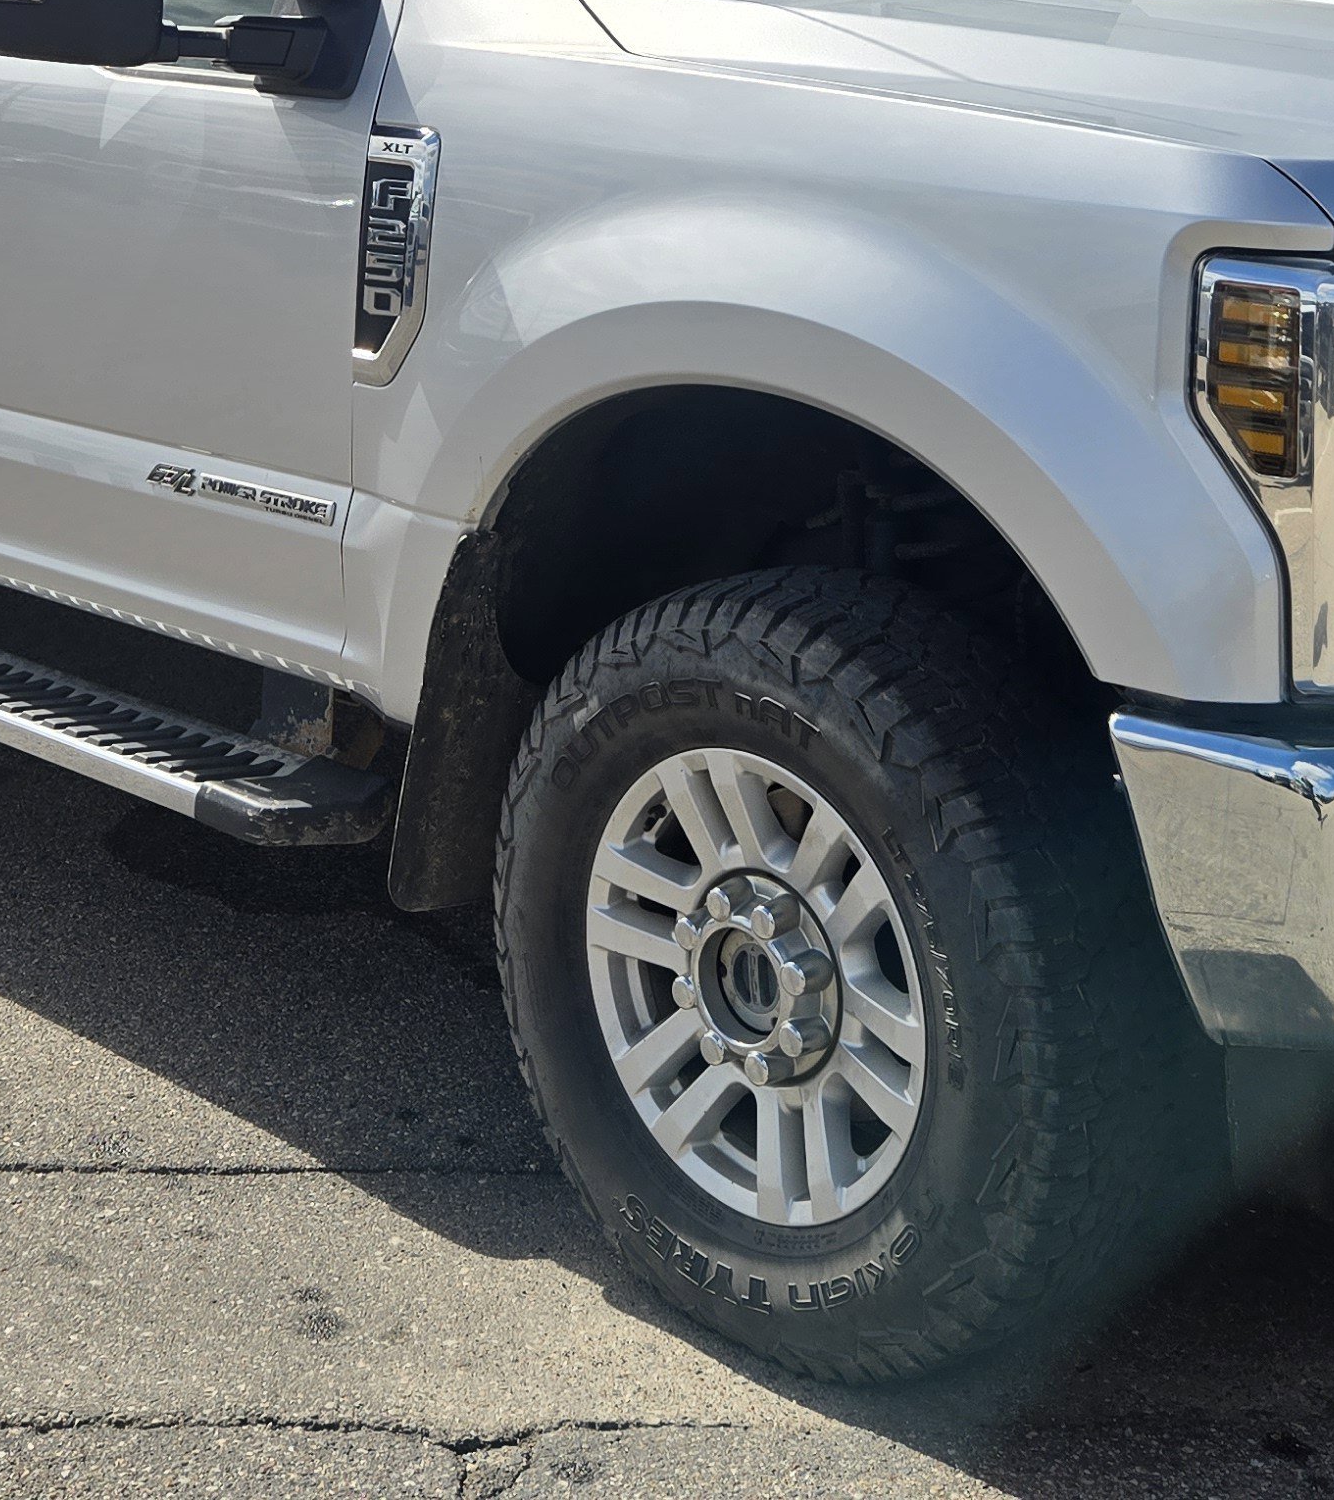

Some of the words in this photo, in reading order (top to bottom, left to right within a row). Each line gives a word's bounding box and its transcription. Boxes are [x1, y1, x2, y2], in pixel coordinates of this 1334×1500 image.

[381, 141, 415, 155] XLT
[259, 489, 328, 518] STROKE
[551, 677, 723, 790] OUTPOST
[619, 1193, 773, 1316] TYRES
